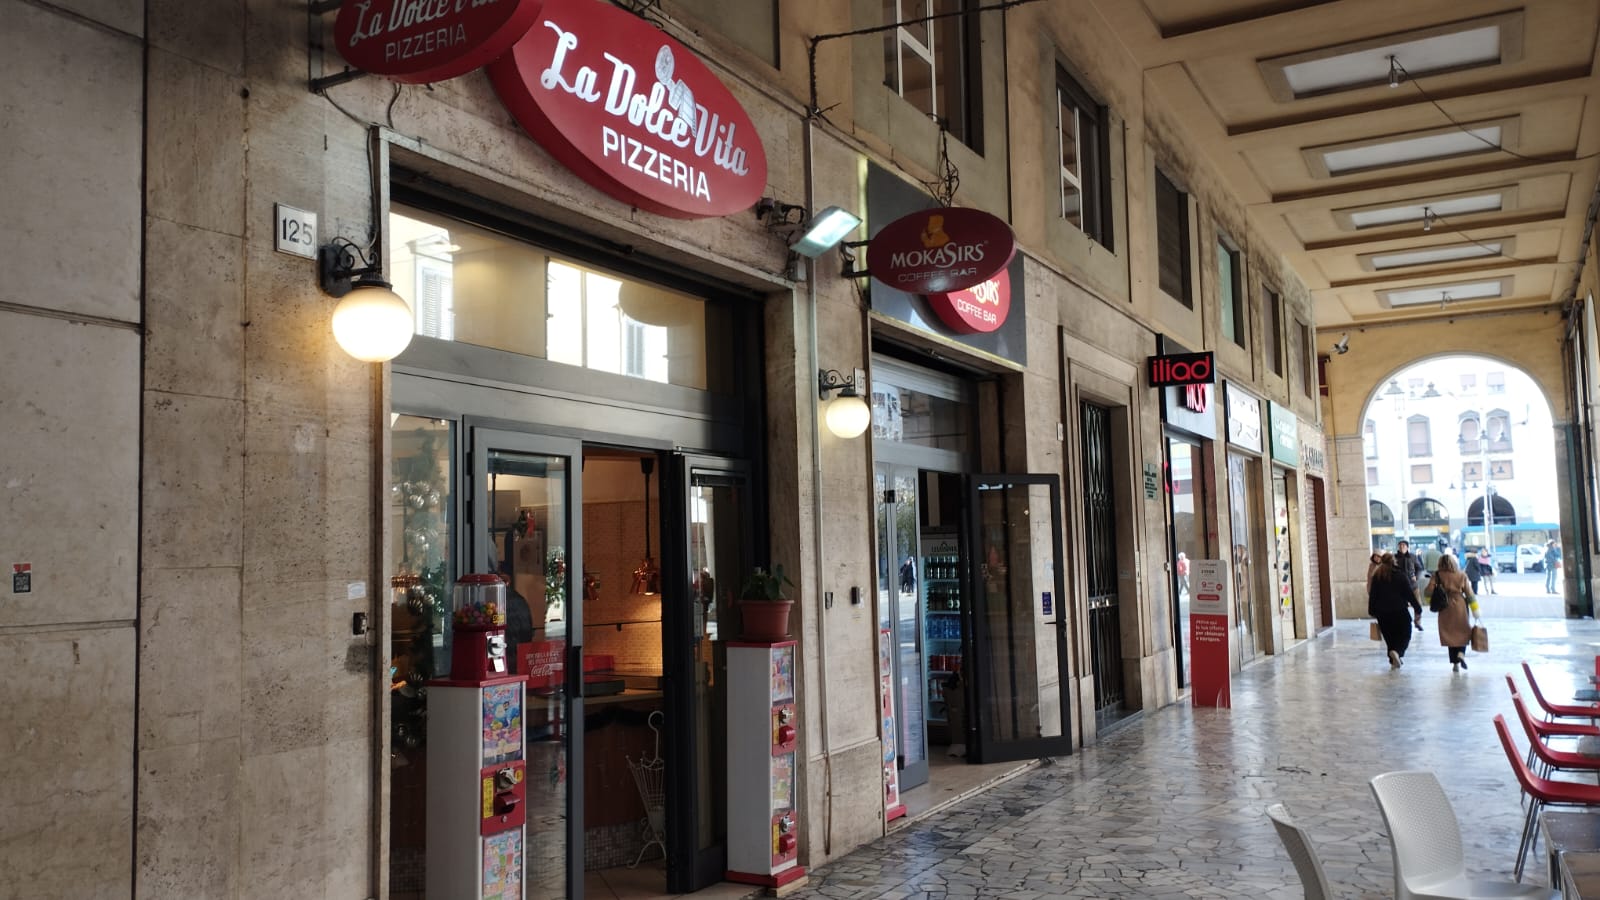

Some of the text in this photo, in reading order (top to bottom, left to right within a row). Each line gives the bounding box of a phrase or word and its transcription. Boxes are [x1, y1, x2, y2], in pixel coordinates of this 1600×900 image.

[350, 2, 384, 47] La
[385, 24, 467, 63] PIZZERIA
[540, 20, 750, 177] La Dolce Vita
[603, 125, 711, 201] PIZZERIA
[282, 216, 313, 246] 125
[890, 242, 985, 269] MOKASIRS
[898, 267, 977, 283] COFFEE BAR
[957, 298, 998, 325] COFFEE BAR
[1152, 355, 1211, 383] iliad
